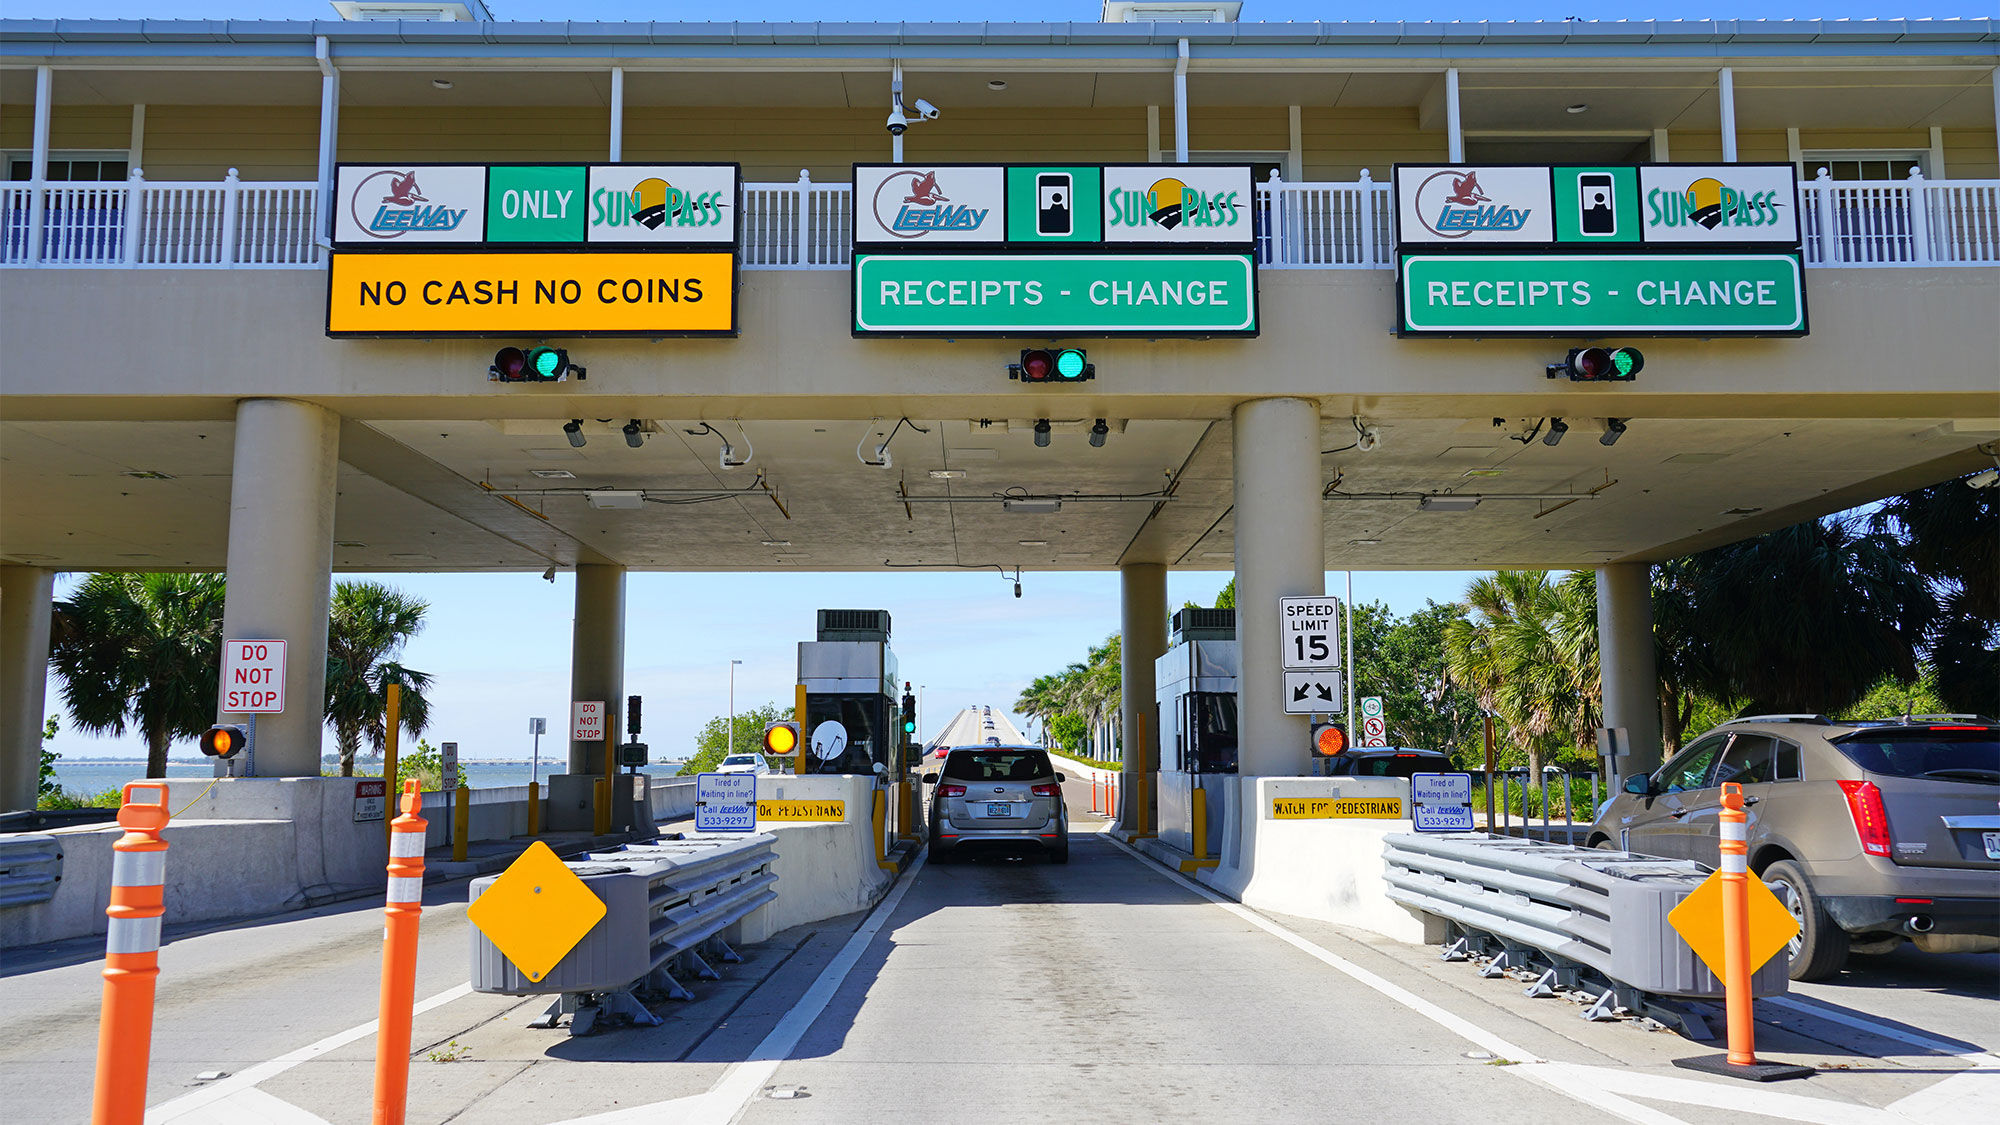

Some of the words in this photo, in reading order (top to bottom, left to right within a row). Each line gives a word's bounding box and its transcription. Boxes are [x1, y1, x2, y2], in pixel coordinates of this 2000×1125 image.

[501, 189, 574, 219] ONLY
[360, 281, 407, 306] NO
[422, 280, 518, 305] CASH
[535, 280, 582, 304] NO
[597, 278, 703, 304] COINS
[880, 280, 1043, 306] RECEIPTS
[1089, 280, 1228, 306] CHANGE
[1428, 280, 1591, 306] RECEIPTS
[1637, 280, 1777, 306] CHANGE
[1287, 605, 1333, 616] SPEED
[1292, 620, 1329, 631] LIMIT
[242, 645, 267, 661] DO
[1295, 635, 1329, 661] 15
[235, 668, 273, 684] NOT
[228, 691, 277, 707] STOP
[583, 704, 596, 713] DO
[579, 717, 598, 726] NOT
[576, 729, 600, 738] STOP
[444, 778, 456, 789] STOP
[714, 779, 731, 787] Tired
[733, 778, 740, 787] of
[1429, 779, 1446, 787] Tired
[1448, 778, 1455, 787] of
[701, 790, 725, 800] Waiting
[727, 790, 734, 798] in
[736, 789, 753, 798] line?
[1417, 790, 1441, 800] Waiting
[1443, 790, 1449, 798] in
[1451, 790, 1467, 798] line?
[702, 805, 717, 814] Call
[756, 804, 771, 816] OR
[1336, 802, 1399, 815] PEDESTRIANS
[1420, 806, 1435, 814] Call
[704, 817, 748, 825] 533-9297
[1424, 817, 1466, 826] 533-9297
